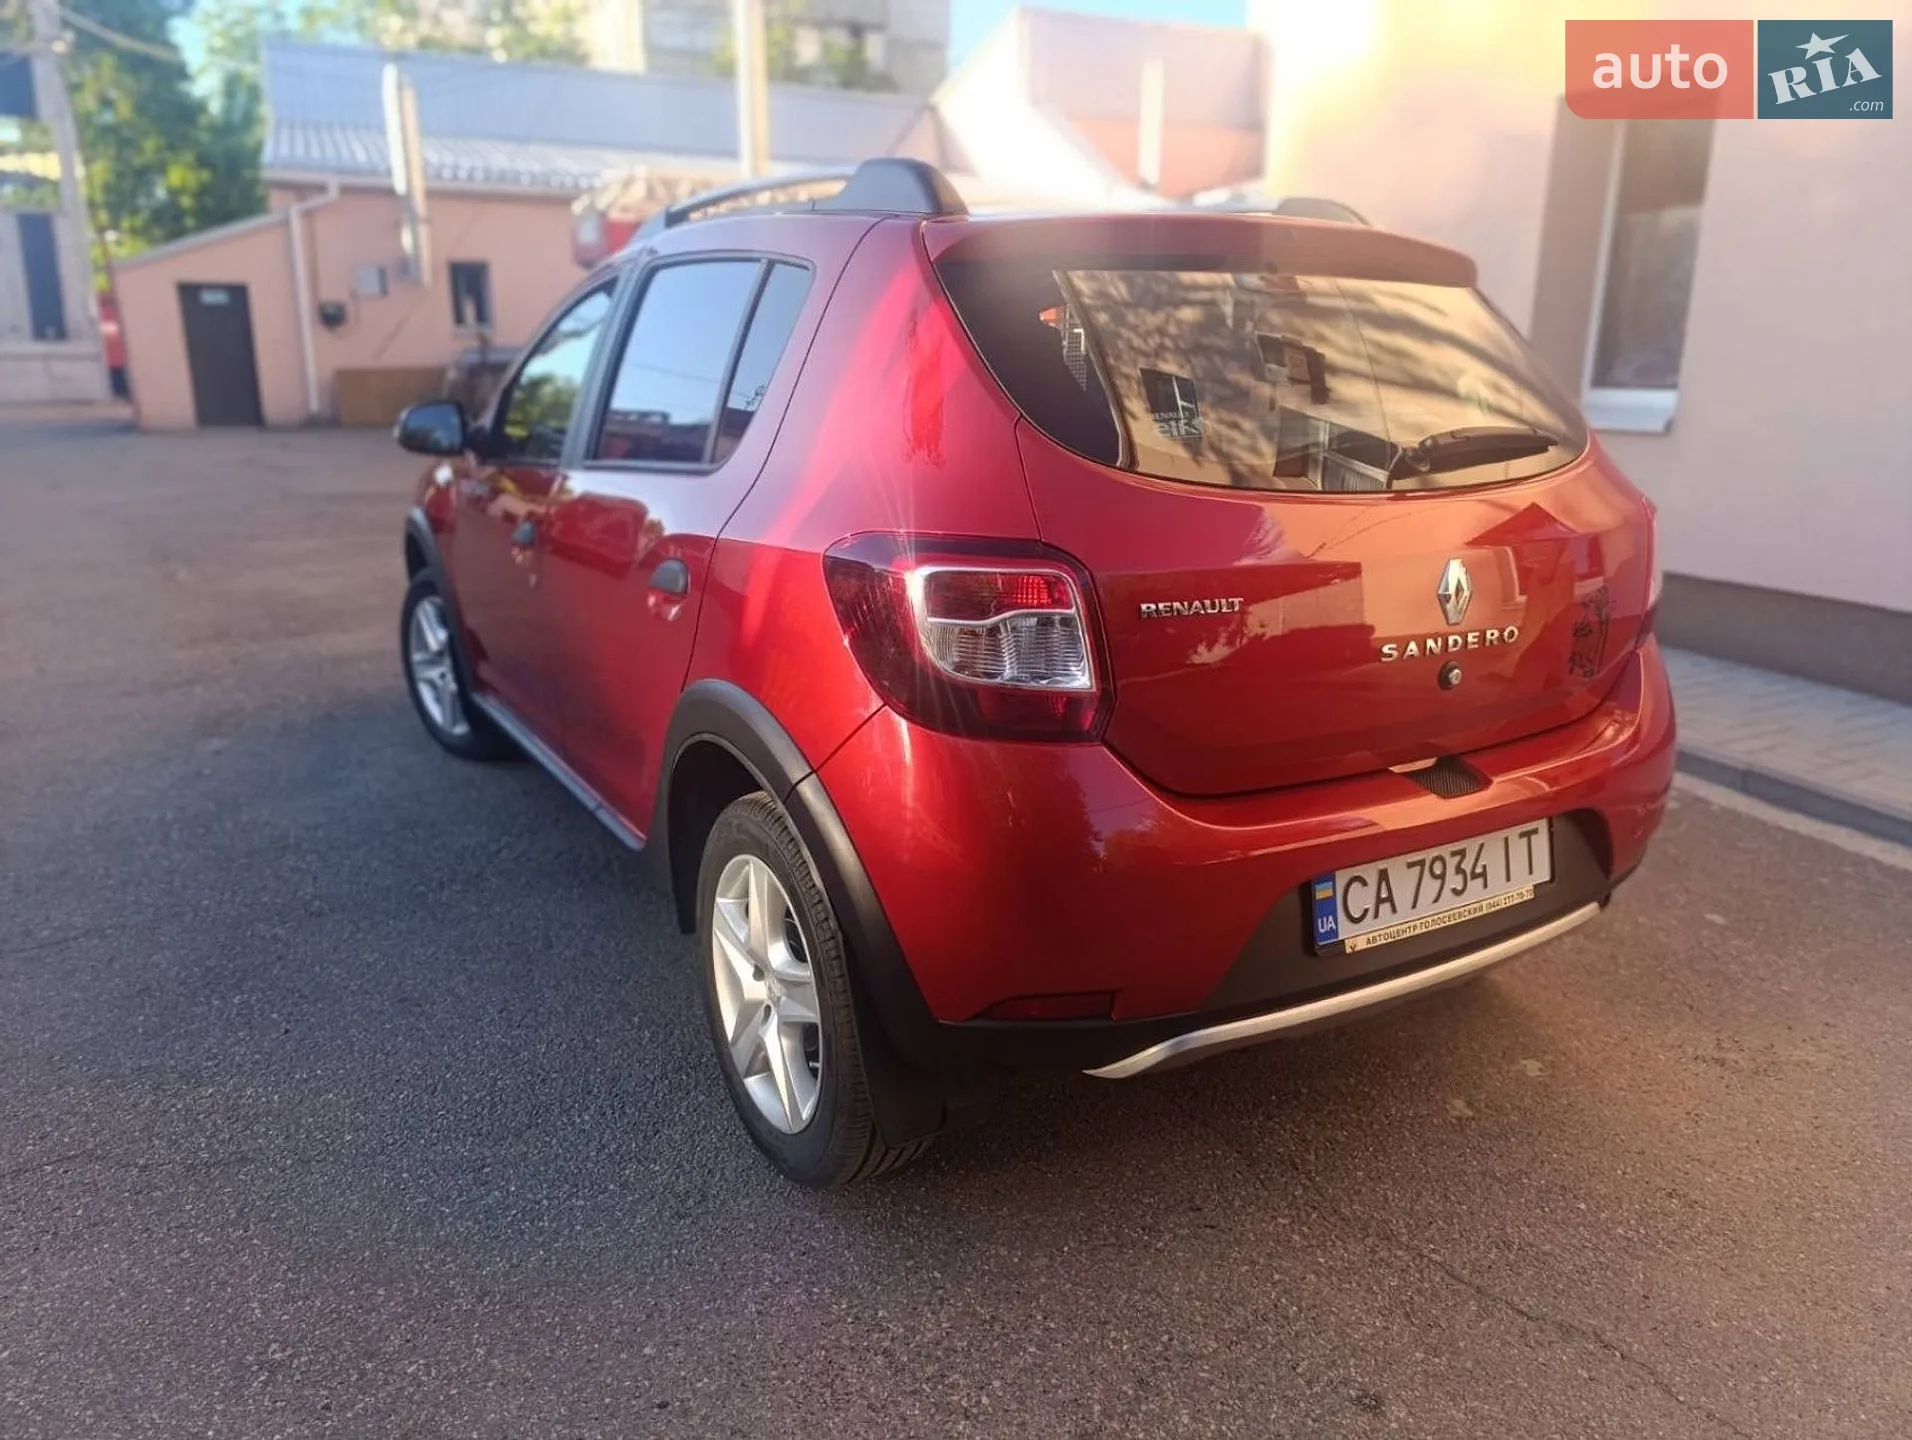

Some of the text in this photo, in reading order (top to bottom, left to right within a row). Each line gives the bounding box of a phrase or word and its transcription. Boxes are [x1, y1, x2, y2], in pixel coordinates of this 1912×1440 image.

[1140, 597, 1243, 618] RENAULT
[1380, 625, 1519, 662] SANDERO
[1342, 827, 1539, 924] CA 7934 IT
[1318, 915, 1336, 933] UA
